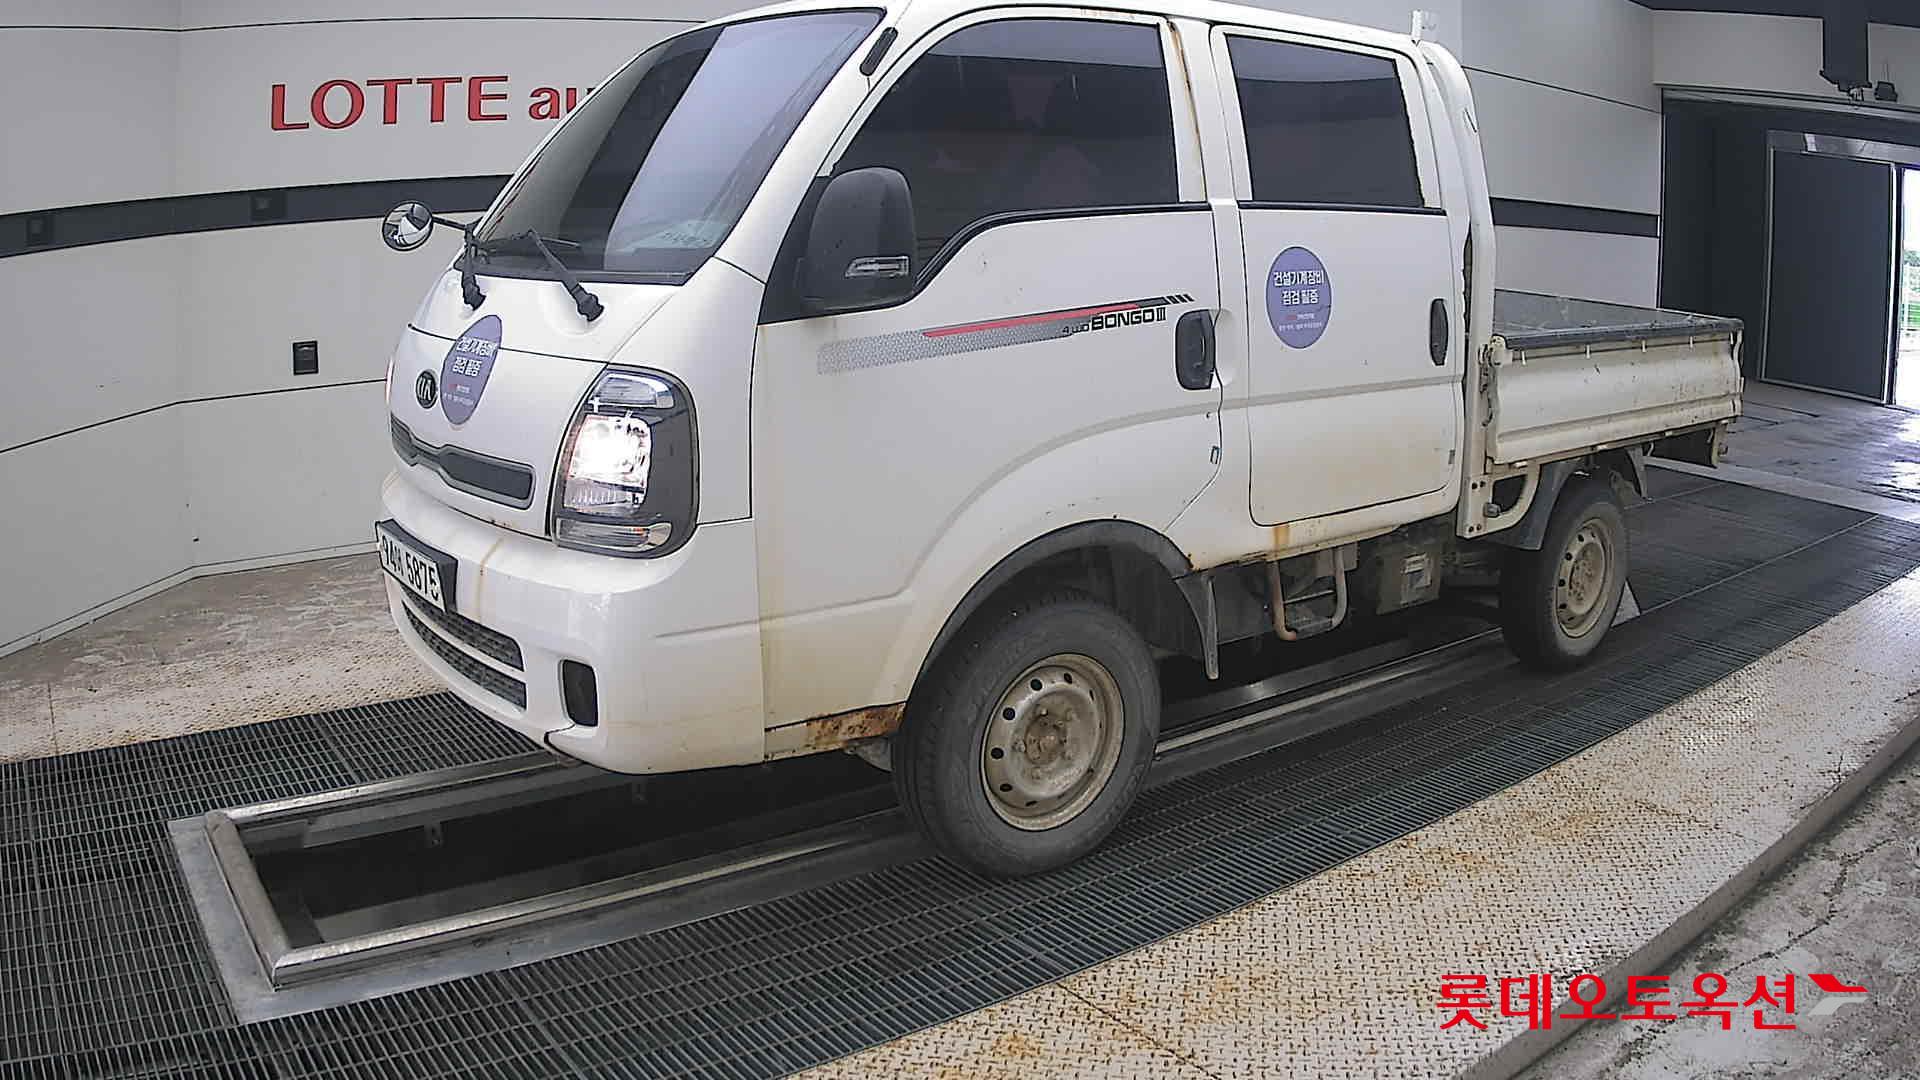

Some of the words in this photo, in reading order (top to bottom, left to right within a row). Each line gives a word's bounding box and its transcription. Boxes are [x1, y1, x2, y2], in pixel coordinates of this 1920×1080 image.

[271, 76, 509, 131] LOTTE
[1091, 309, 1155, 331] BONGO
[406, 551, 439, 601] 5875
